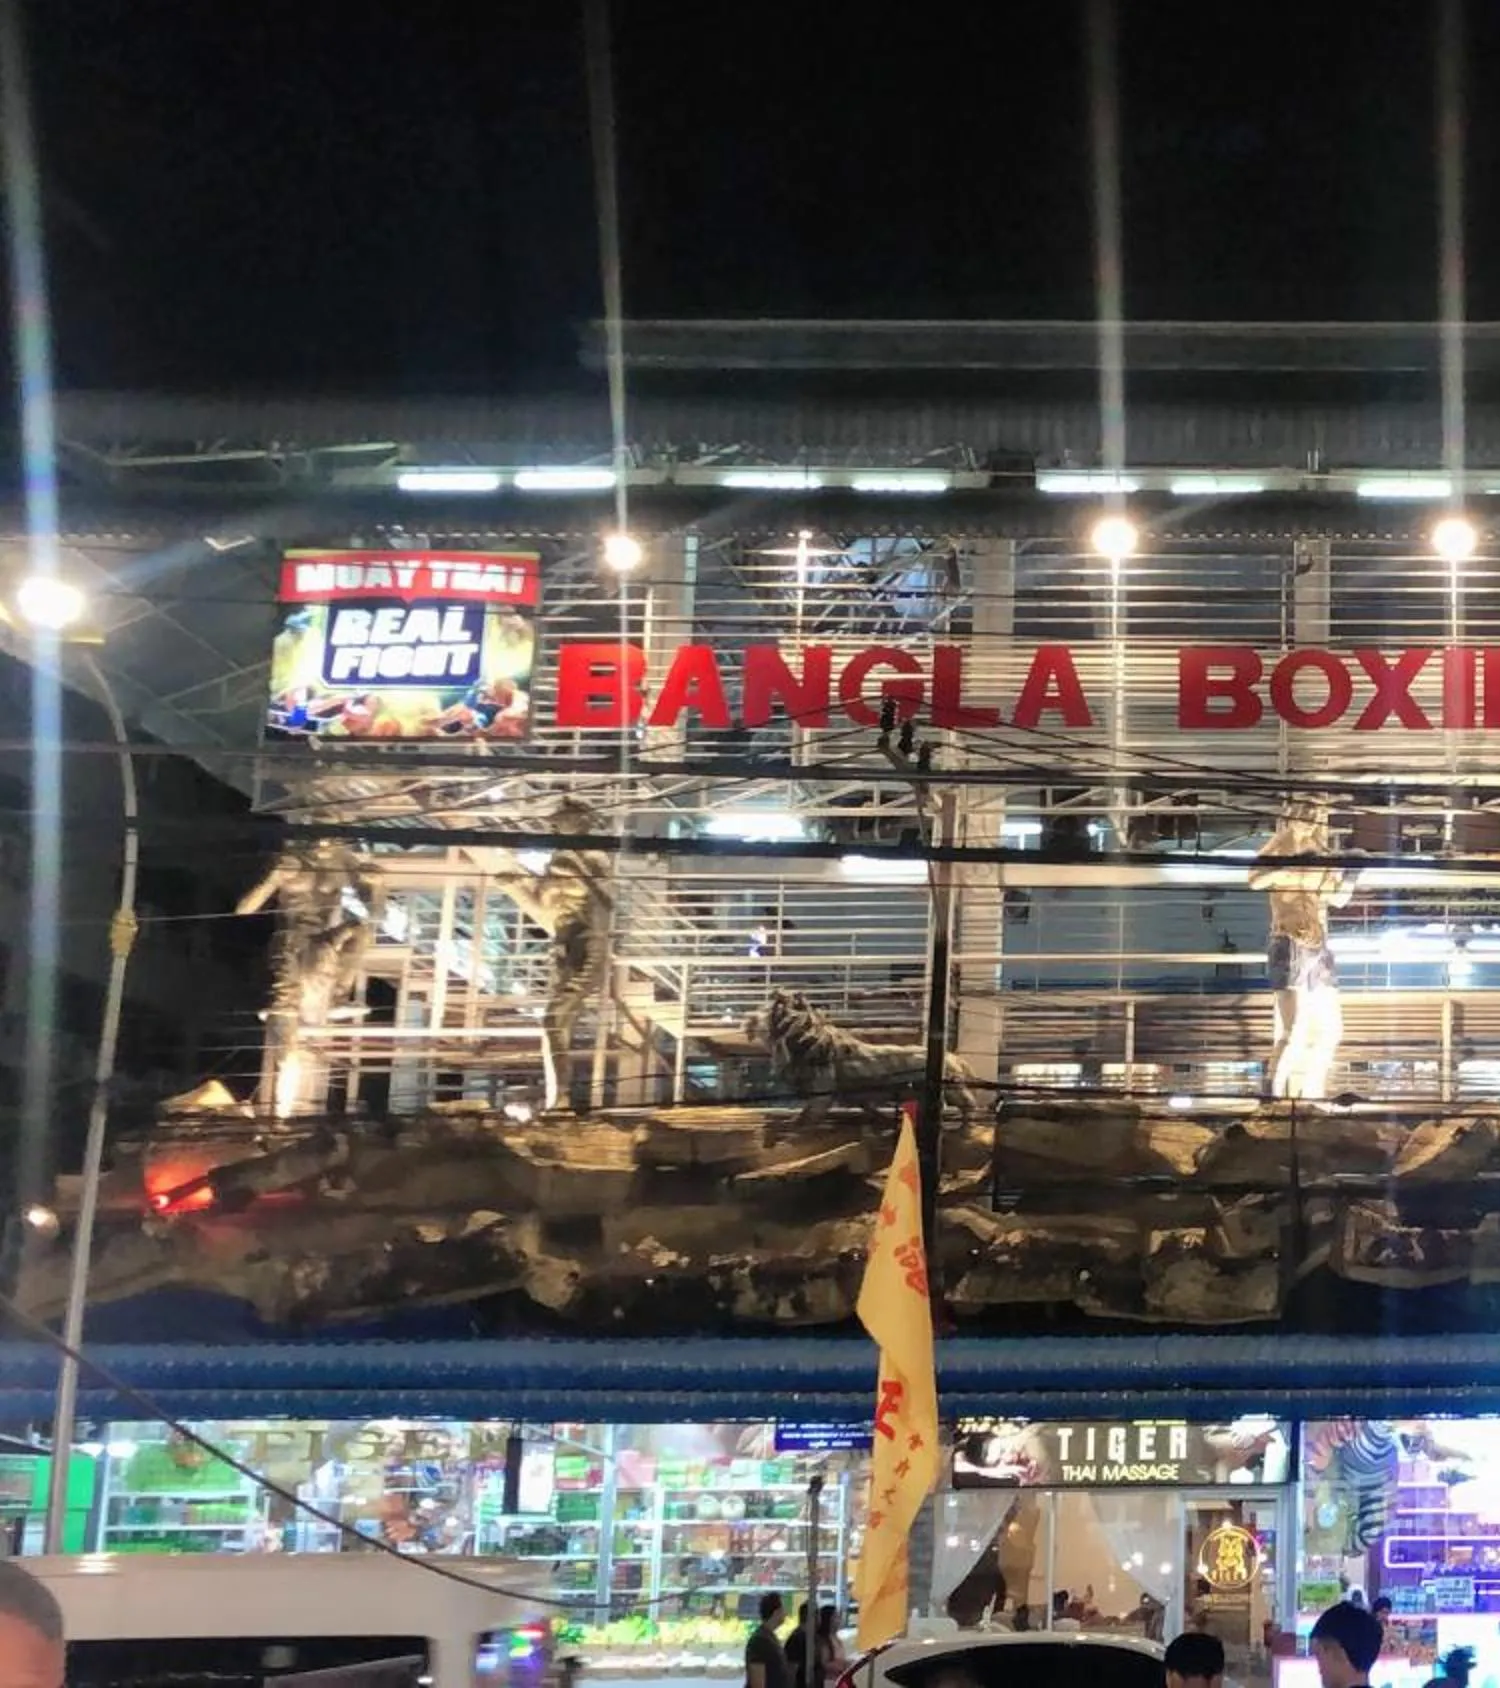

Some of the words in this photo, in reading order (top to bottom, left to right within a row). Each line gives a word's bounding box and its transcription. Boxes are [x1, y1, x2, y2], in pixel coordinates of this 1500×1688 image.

[296, 561, 422, 592] MUAY
[331, 606, 473, 645] REAL
[330, 643, 479, 680] FIGHT
[554, 643, 1093, 729] BANGLA
[1056, 1426, 1188, 1464] TIGER
[1062, 1466, 1098, 1480] THAI
[1103, 1464, 1180, 1480] MASSAGE
